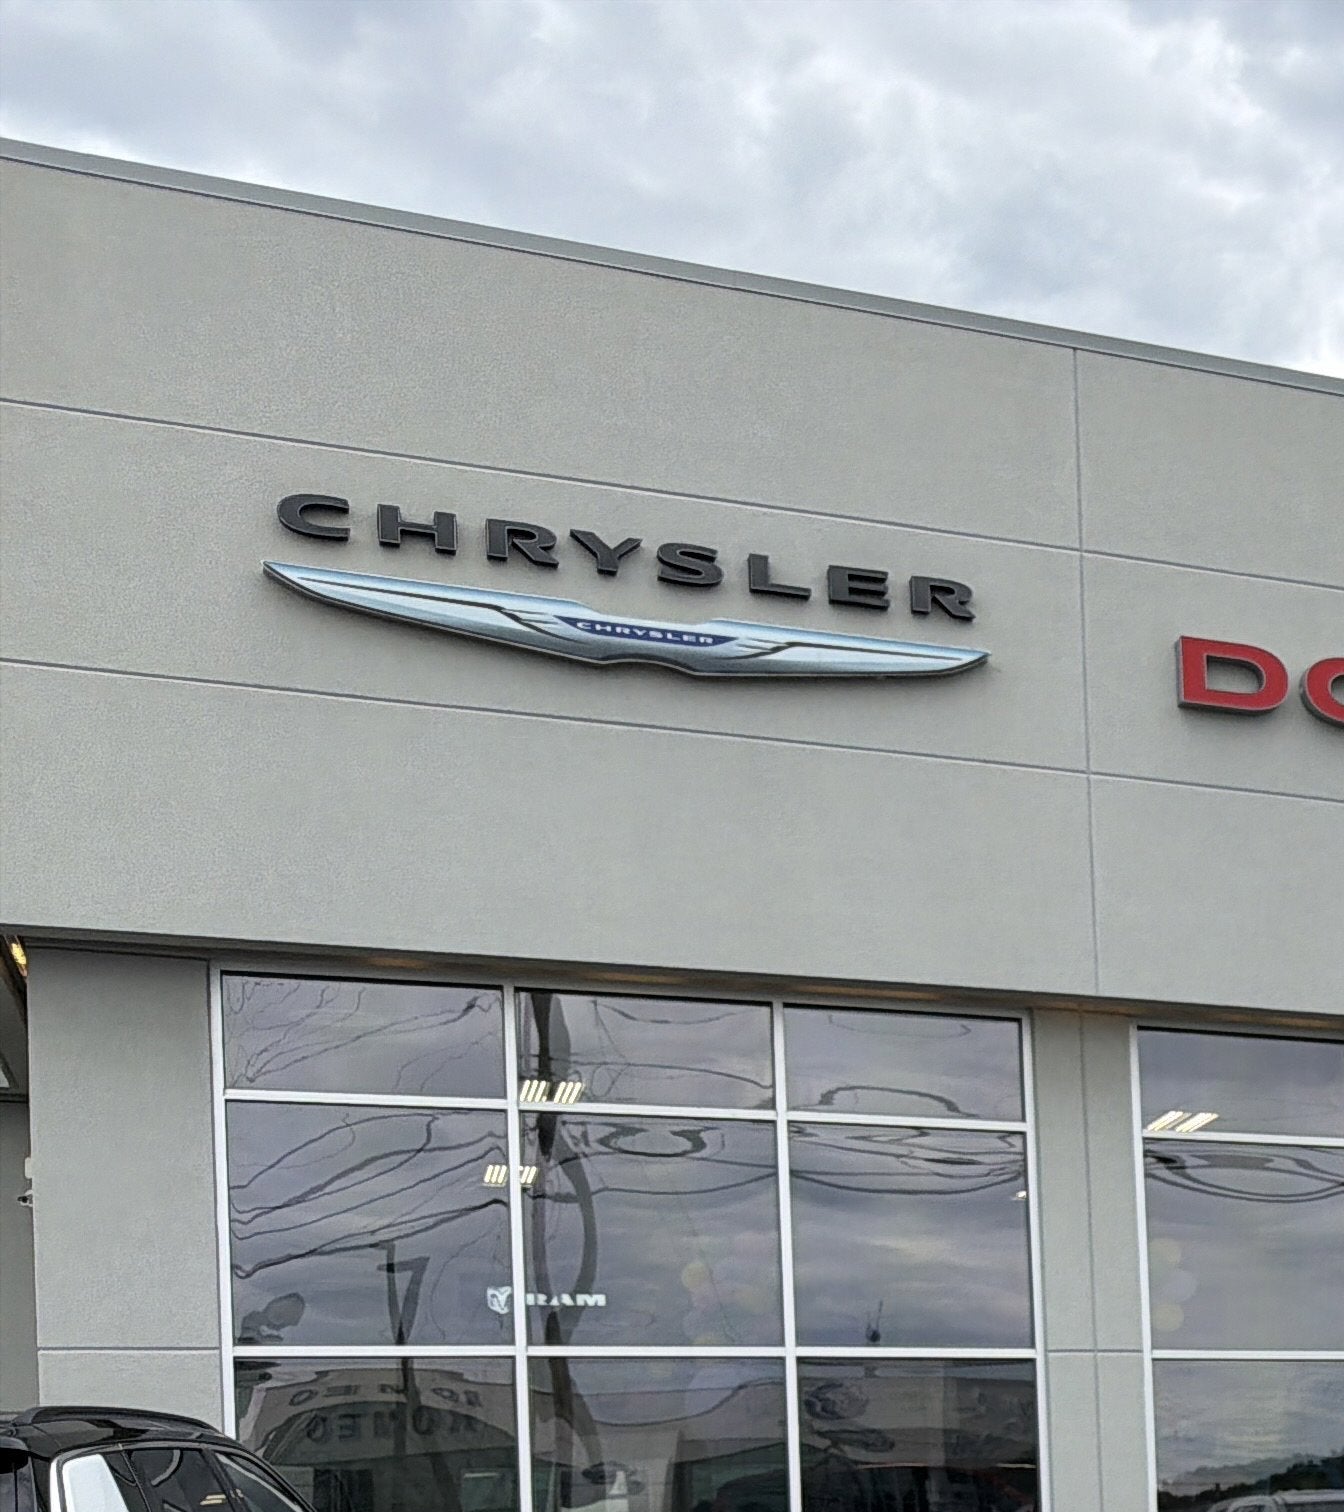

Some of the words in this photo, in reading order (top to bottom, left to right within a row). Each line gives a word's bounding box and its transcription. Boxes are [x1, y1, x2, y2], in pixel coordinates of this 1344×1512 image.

[276, 493, 977, 621] CHRYSLER
[576, 621, 714, 644] CHRYSLER
[525, 1292, 607, 1307] RAM
